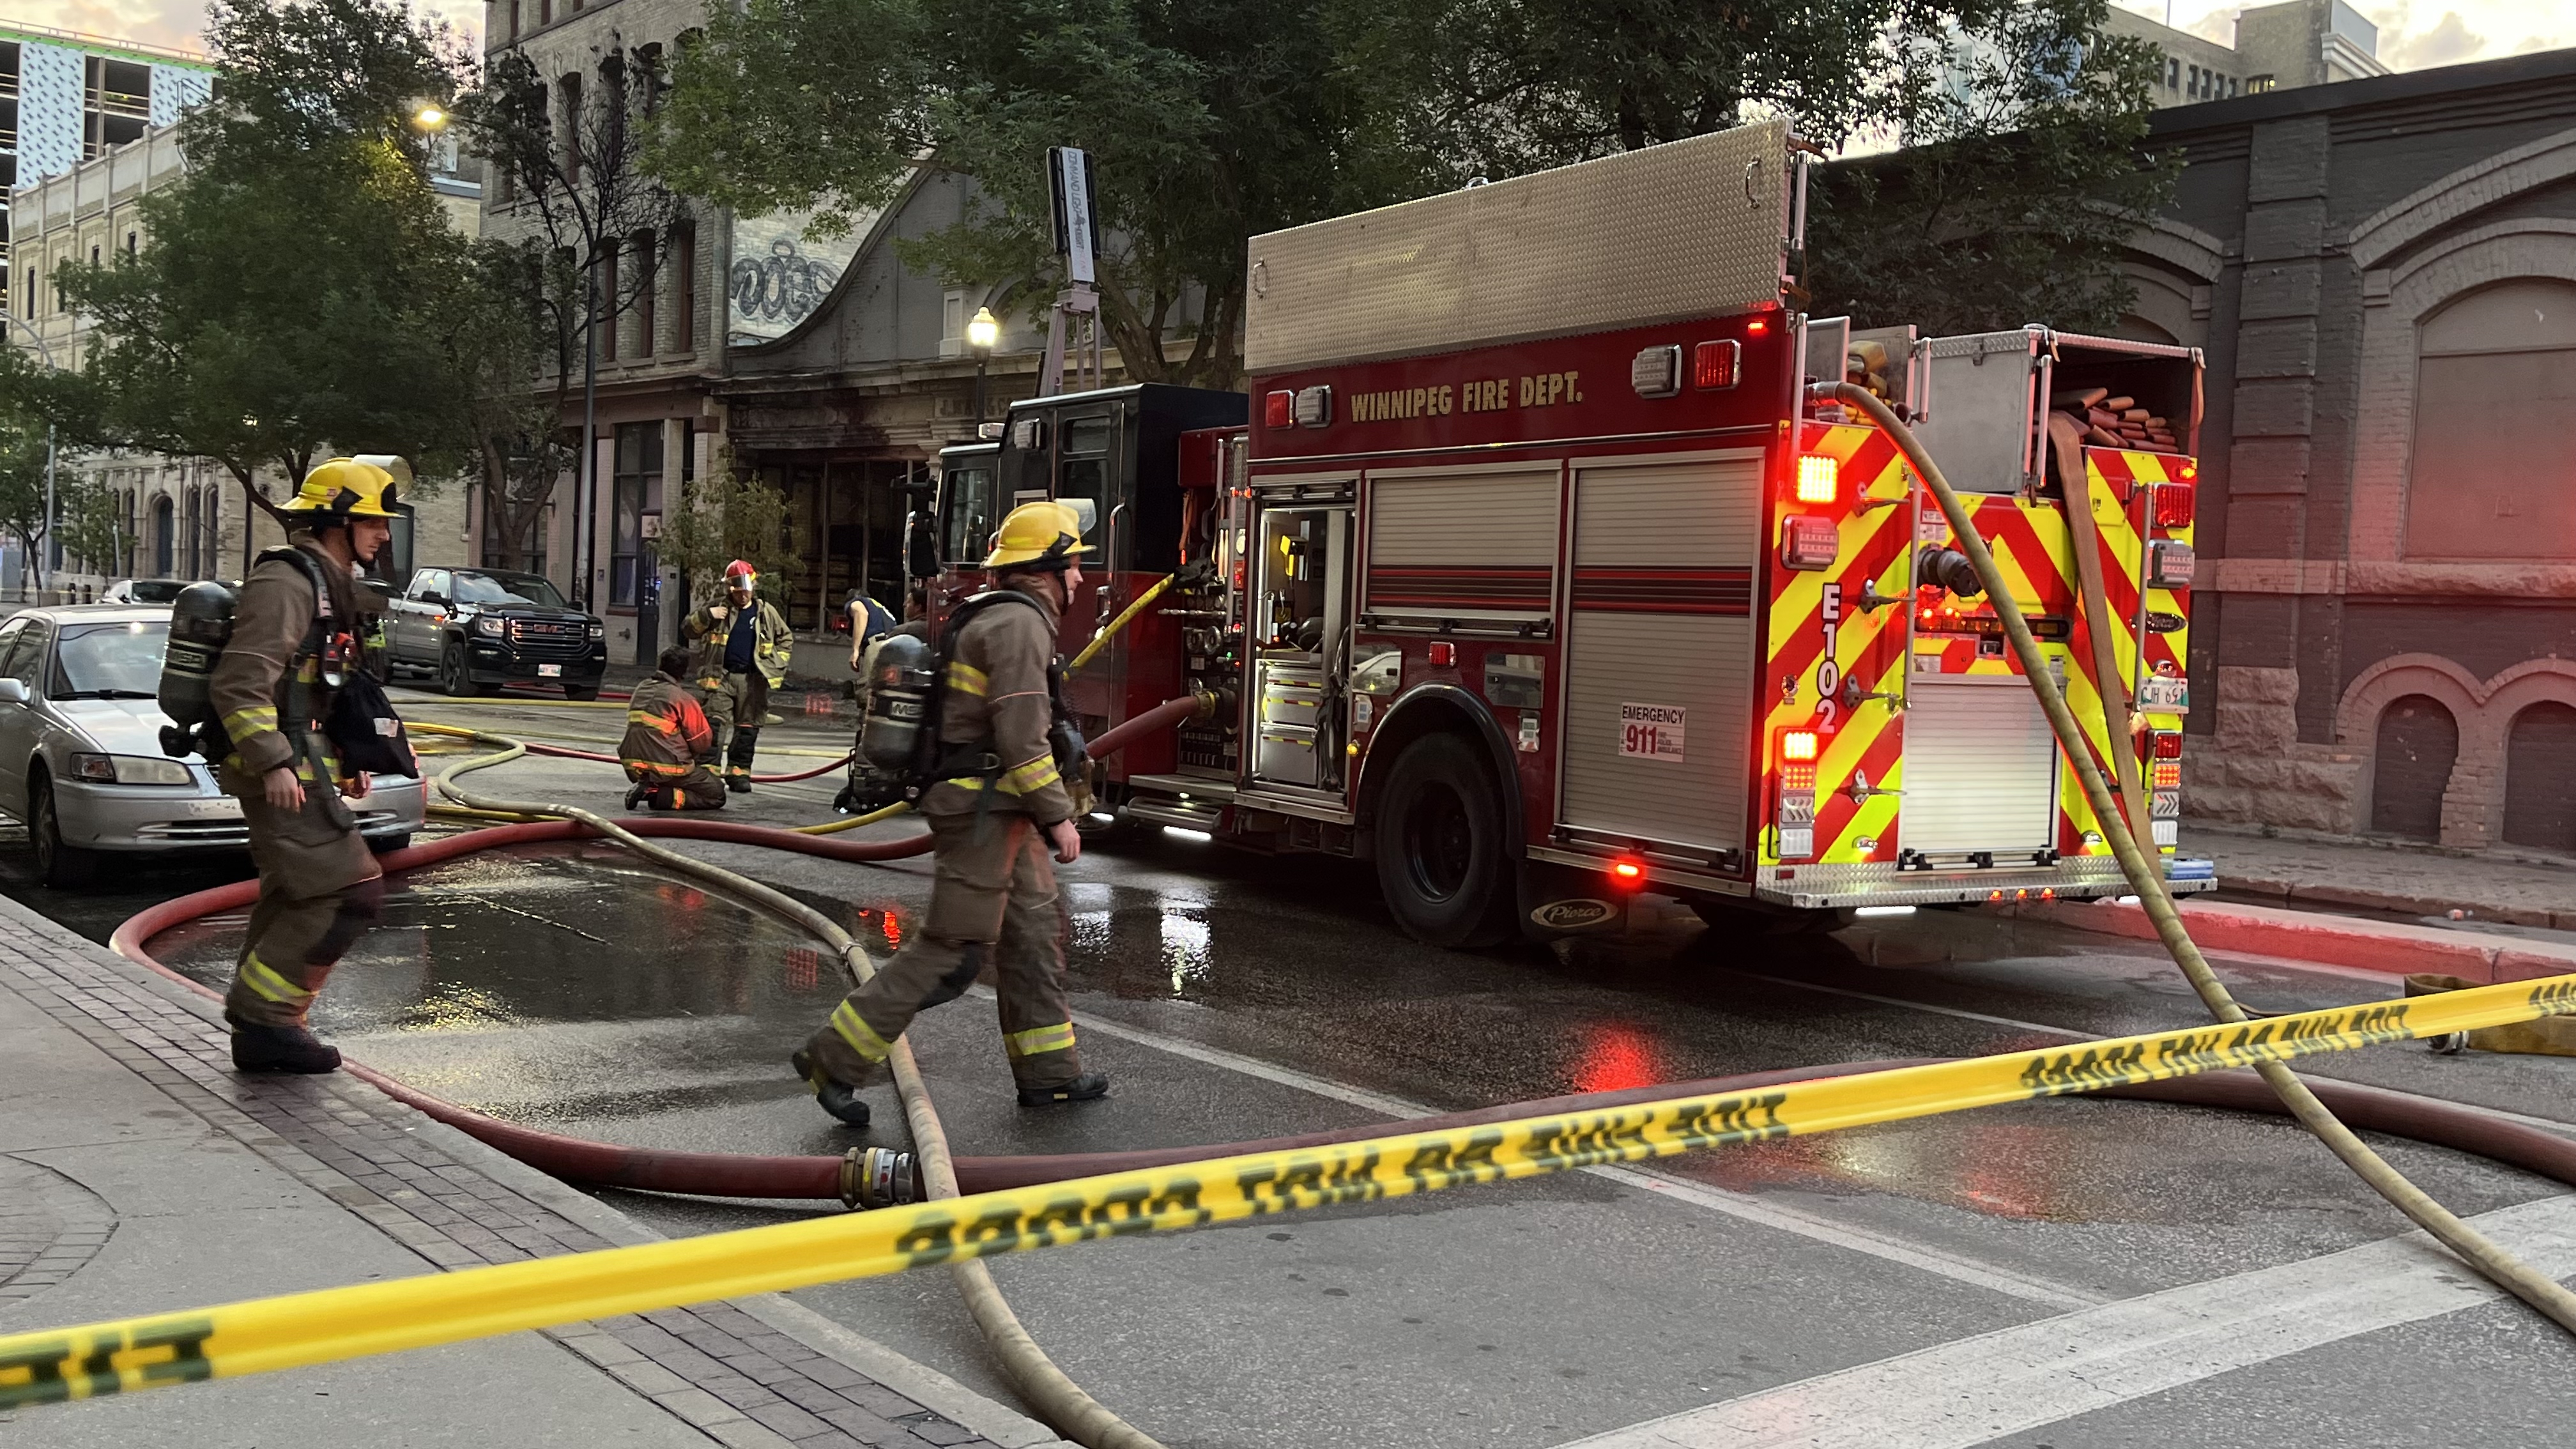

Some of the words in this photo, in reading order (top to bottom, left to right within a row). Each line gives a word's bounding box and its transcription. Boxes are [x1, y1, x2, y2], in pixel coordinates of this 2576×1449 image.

[1351, 385, 1452, 422] WINNIPEG
[1463, 378, 1509, 412] FIRE
[1520, 371, 1583, 408] DEPT.
[534, 624, 565, 634] GMC
[1815, 582, 1842, 734] E102
[1622, 705, 1685, 724] EMERGENCY
[1626, 724, 1657, 755] 911
[1549, 906, 1602, 922] Pierce
